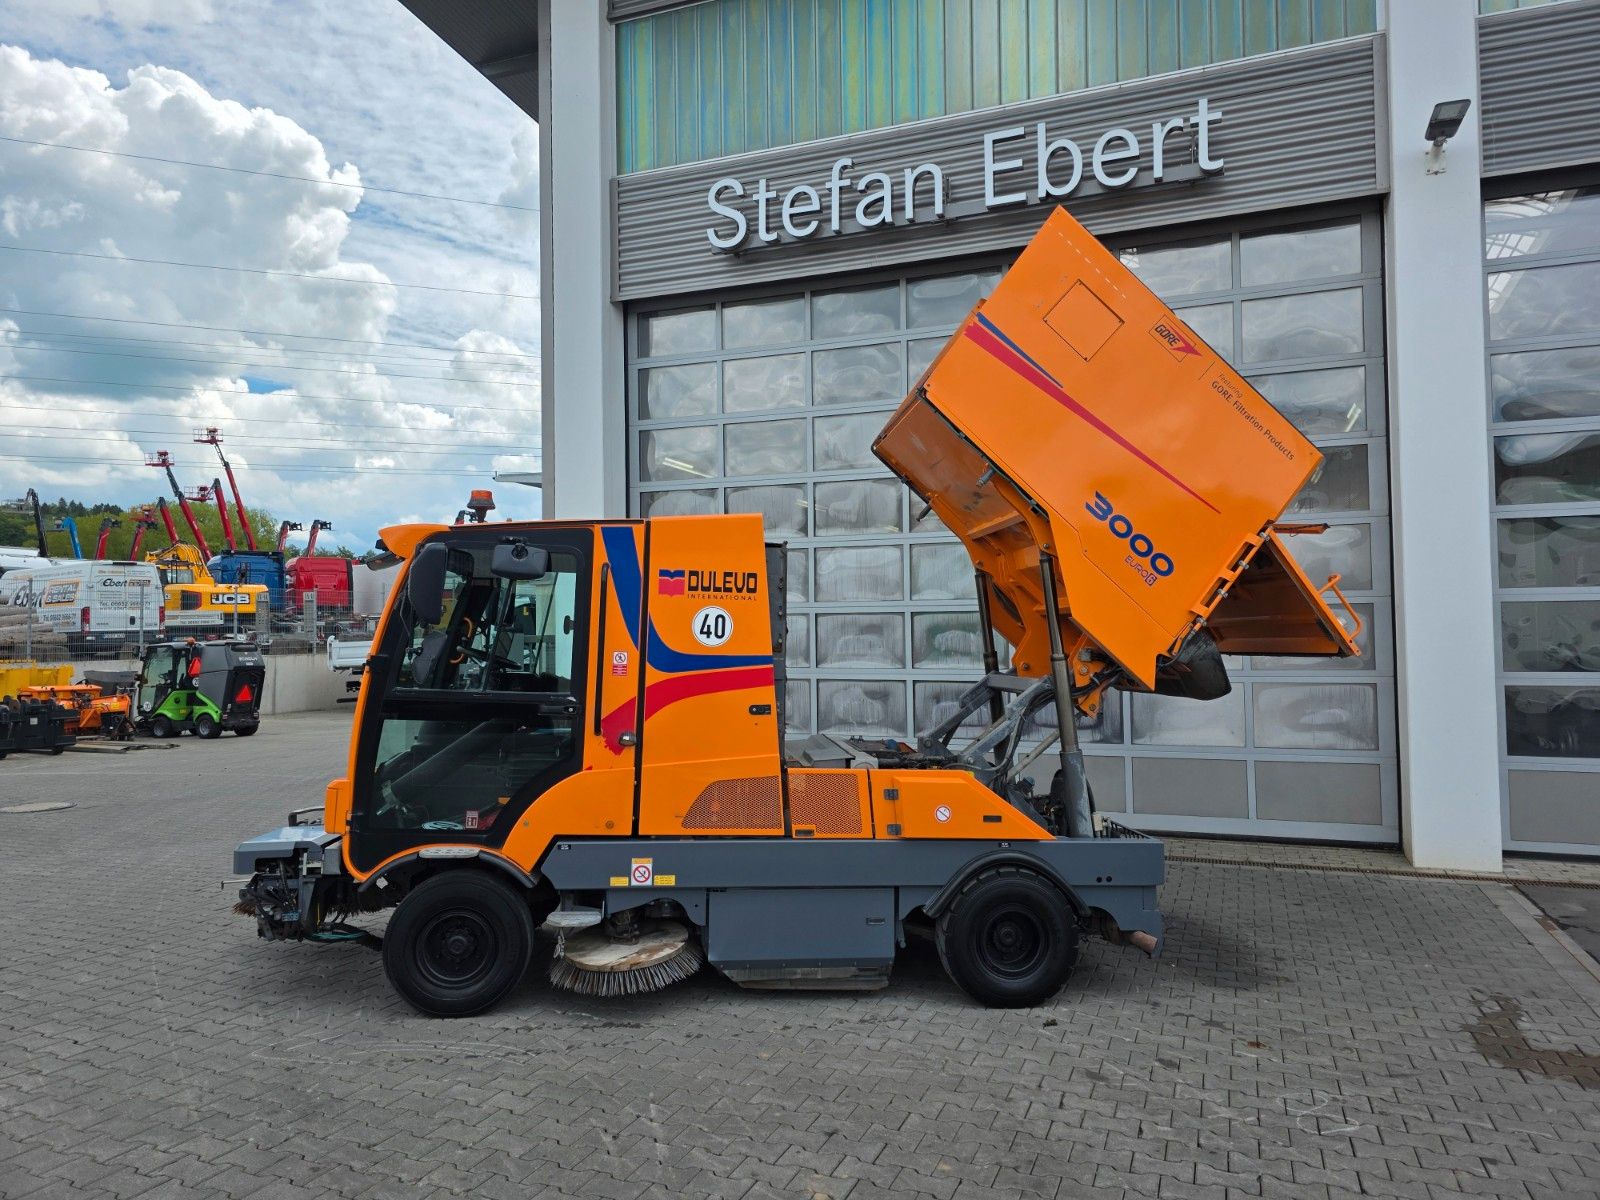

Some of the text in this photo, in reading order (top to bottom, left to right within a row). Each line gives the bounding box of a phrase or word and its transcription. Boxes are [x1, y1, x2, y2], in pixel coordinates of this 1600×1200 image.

[706, 98, 1224, 249] Stefan Ebert
[1154, 324, 1181, 347] GORE
[1218, 371, 1244, 399] Featuring
[1211, 380, 1295, 461] GORE Filtration Products
[1085, 489, 1175, 577] 3000
[102, 578, 128, 588] Ebert
[687, 569, 758, 594] DULEVO
[211, 593, 251, 605] JCB
[687, 593, 758, 601] INTERNATIONAL
[699, 613, 727, 640] 40
